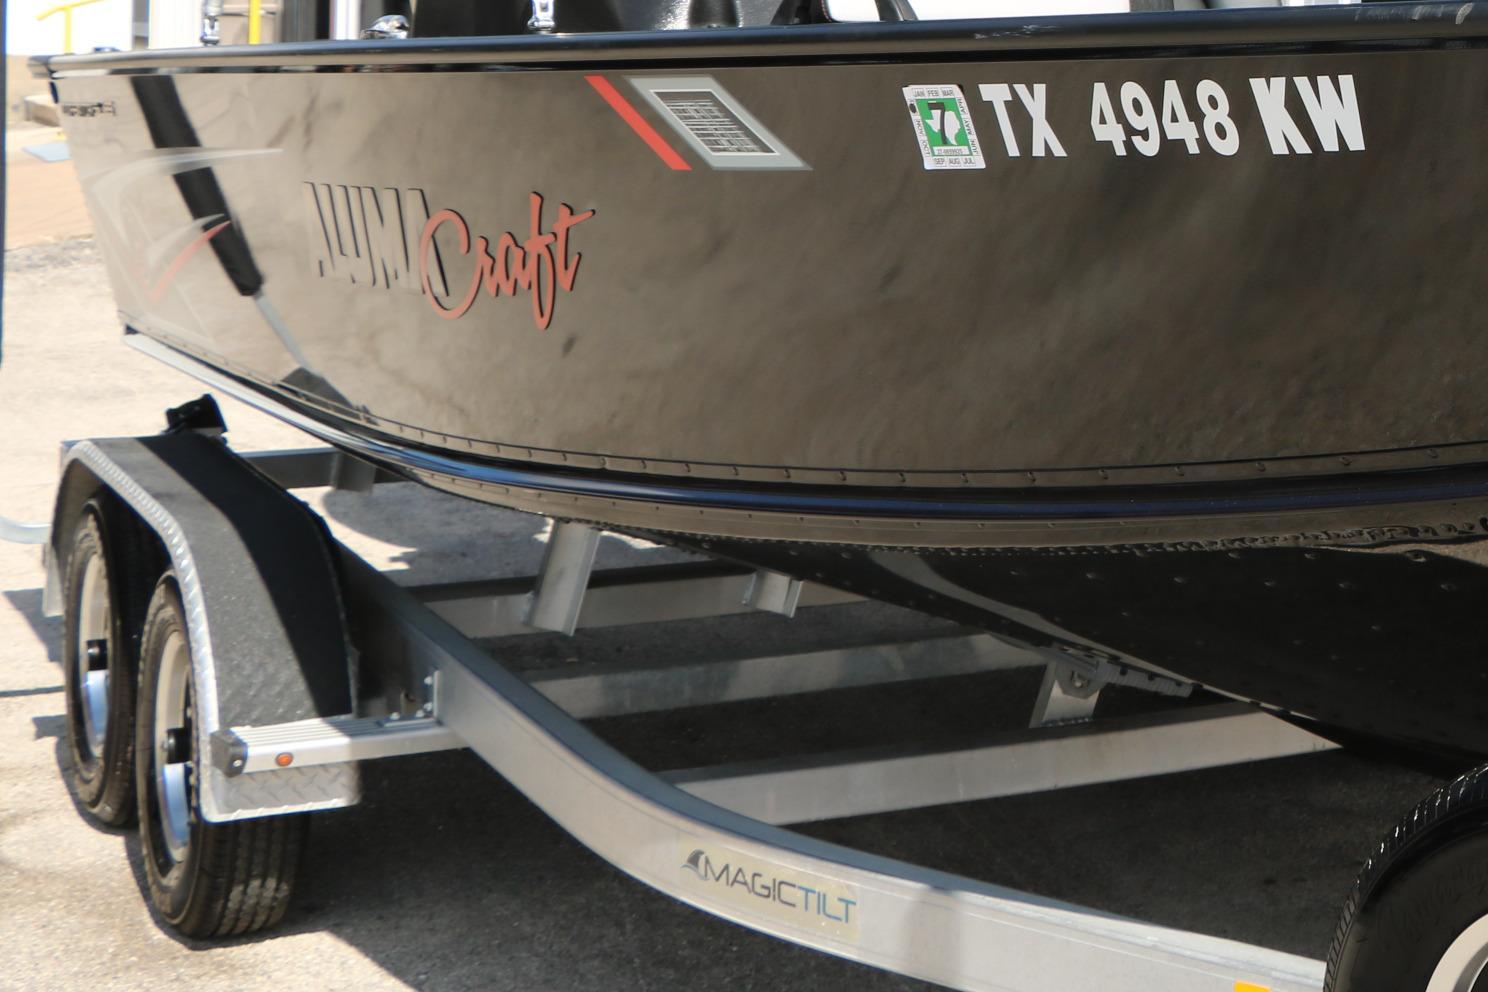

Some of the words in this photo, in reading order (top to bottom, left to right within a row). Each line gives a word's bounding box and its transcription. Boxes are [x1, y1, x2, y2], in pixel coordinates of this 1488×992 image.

[927, 101, 946, 145] 7
[978, 83, 1068, 157] TX
[1090, 79, 1241, 157] 4948
[1248, 74, 1366, 155] KW
[703, 855, 857, 924] MAGICTILT
